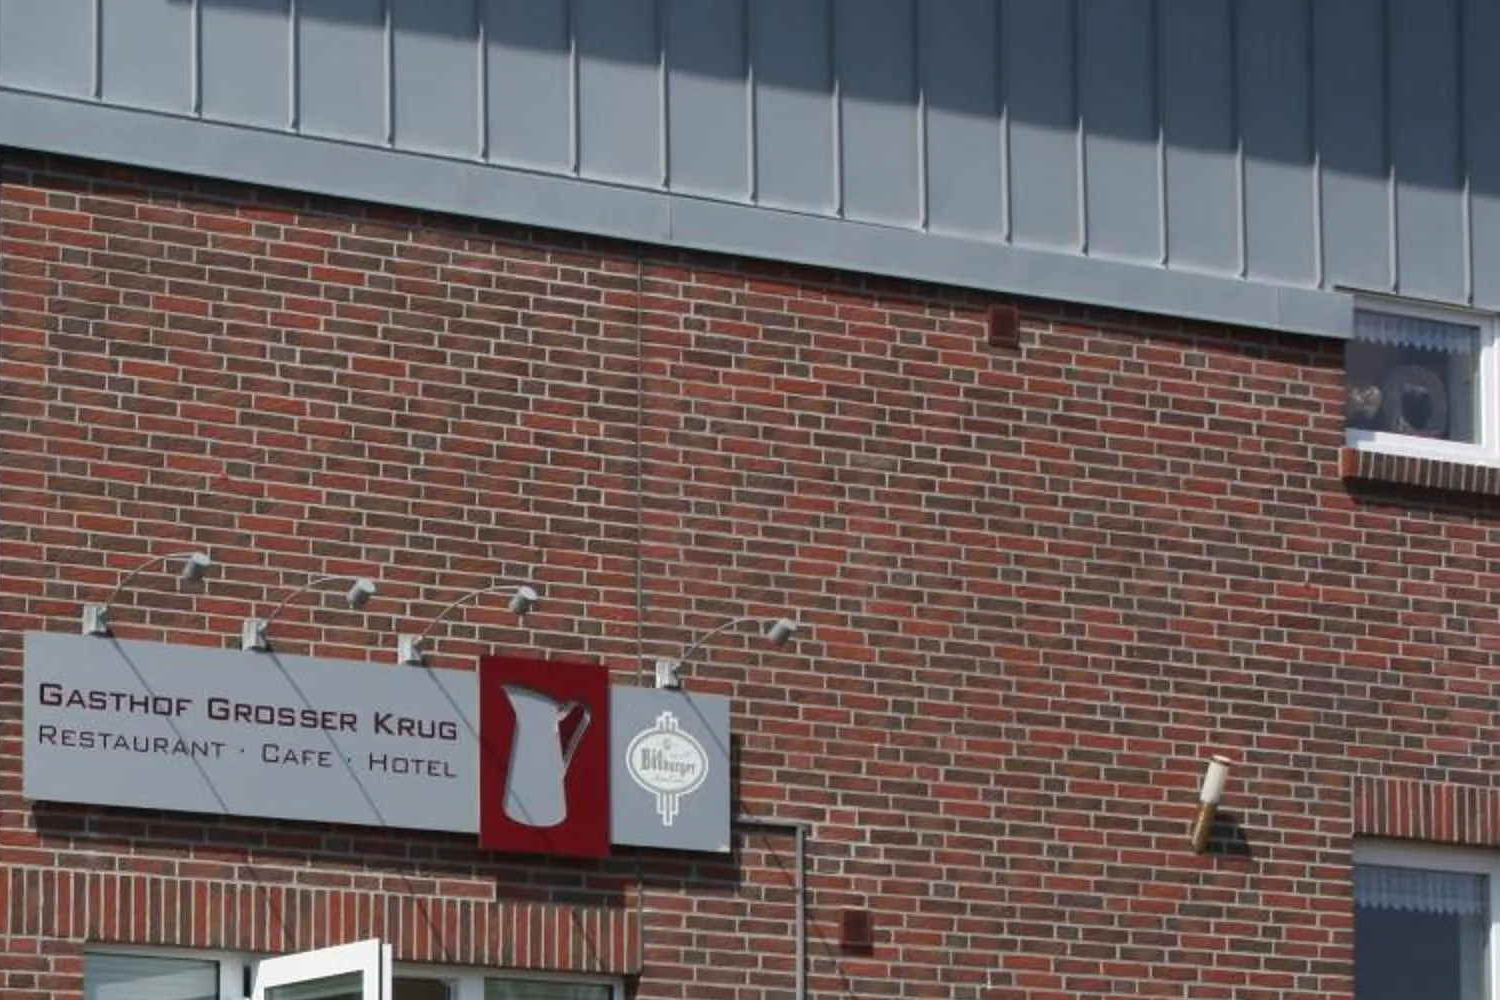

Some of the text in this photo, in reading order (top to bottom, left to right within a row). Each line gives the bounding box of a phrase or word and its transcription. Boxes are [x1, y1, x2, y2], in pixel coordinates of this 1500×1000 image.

[39, 682, 458, 741] GASTHOF GROSSER KRUG
[38, 724, 458, 779] RESTAURANT CAFE HOTEL
